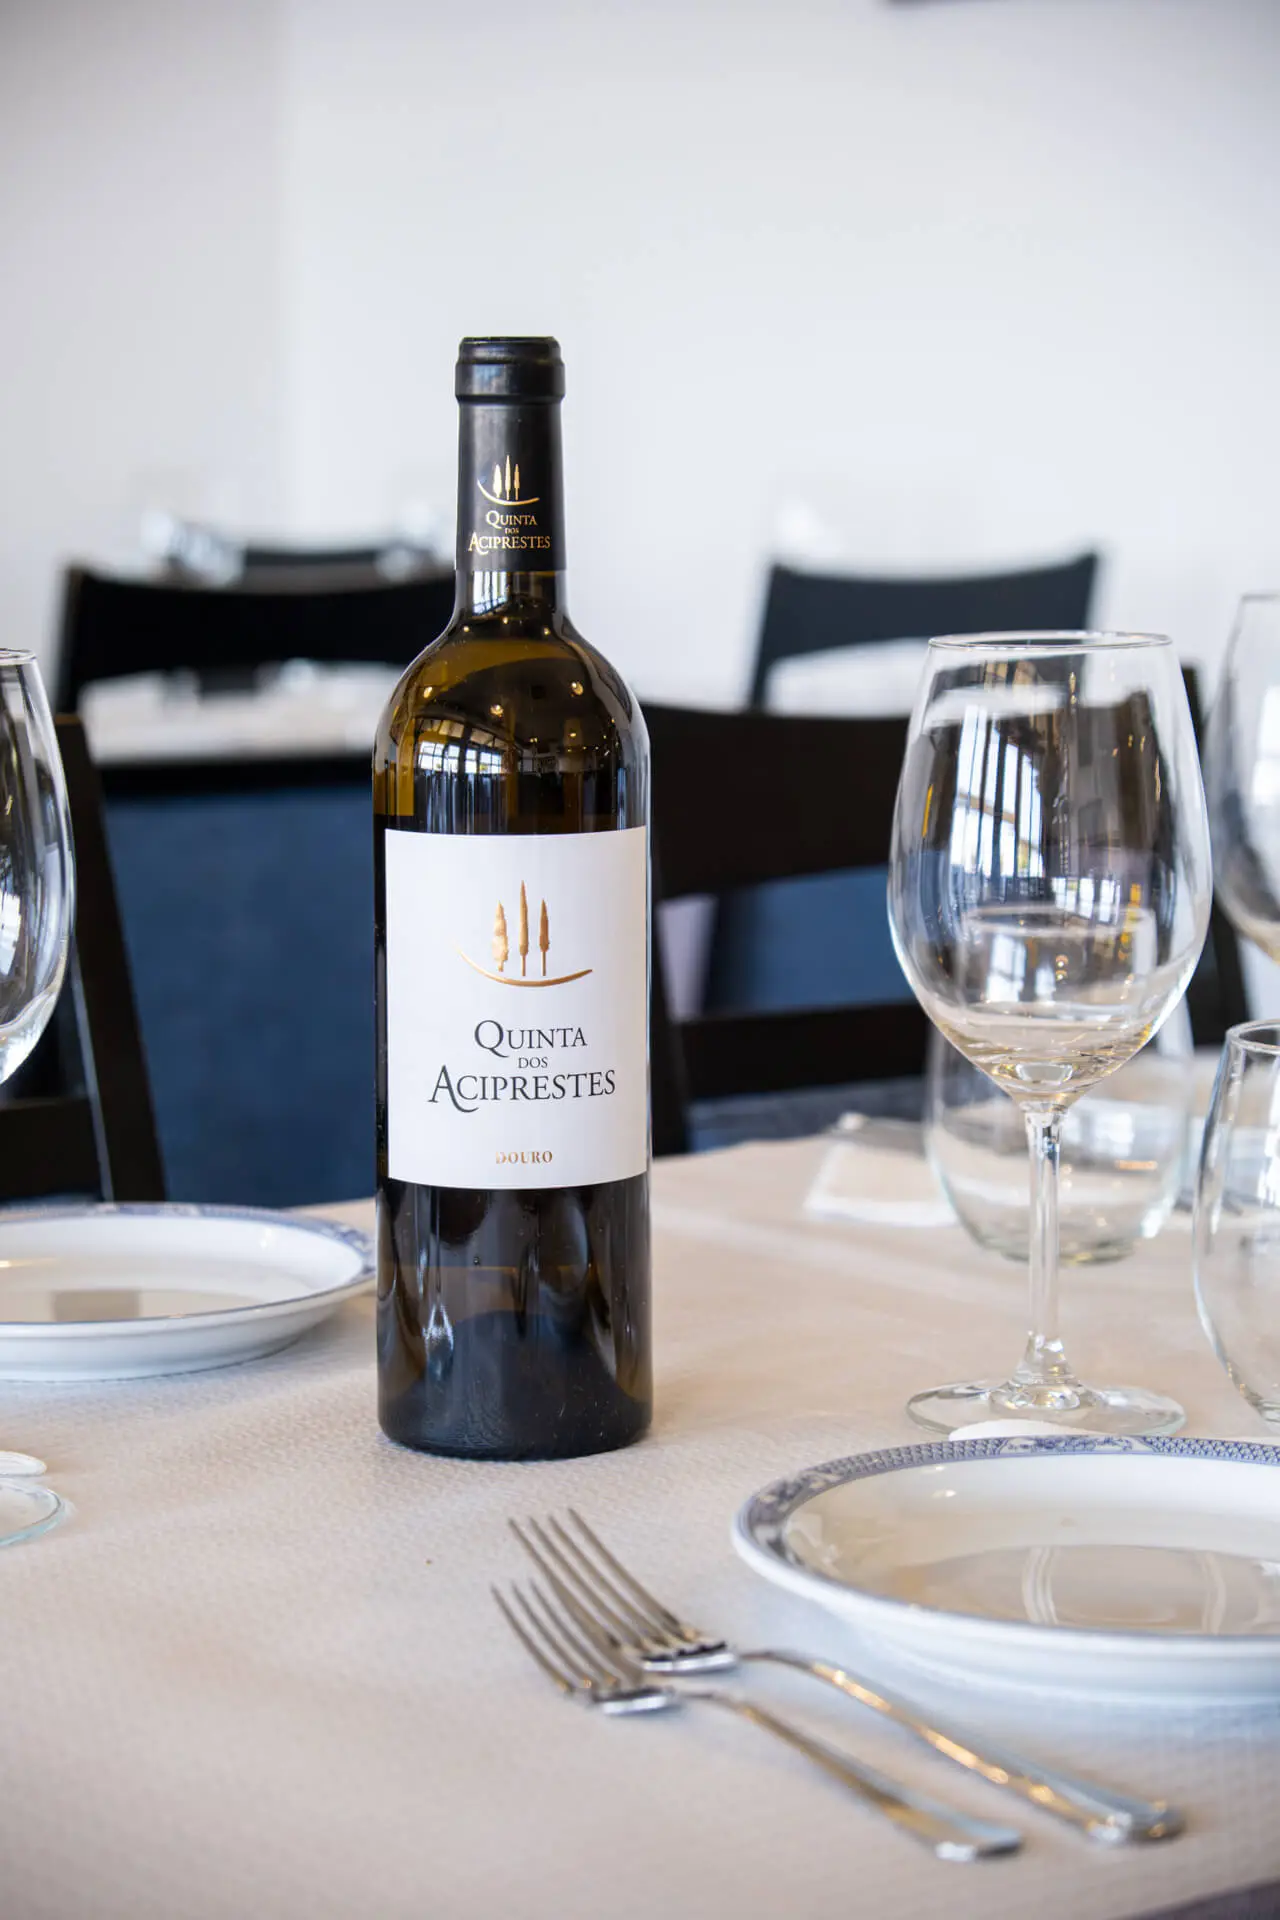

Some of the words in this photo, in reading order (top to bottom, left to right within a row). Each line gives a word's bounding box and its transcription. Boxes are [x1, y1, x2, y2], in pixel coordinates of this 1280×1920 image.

[486, 510, 537, 529] QUINTA
[468, 532, 551, 555] ACIPRESTES
[474, 1020, 587, 1058] QUINTA
[518, 1057, 548, 1069] DOS
[428, 1065, 616, 1113] ACIPRESTES
[495, 1151, 553, 1164] DOURO
